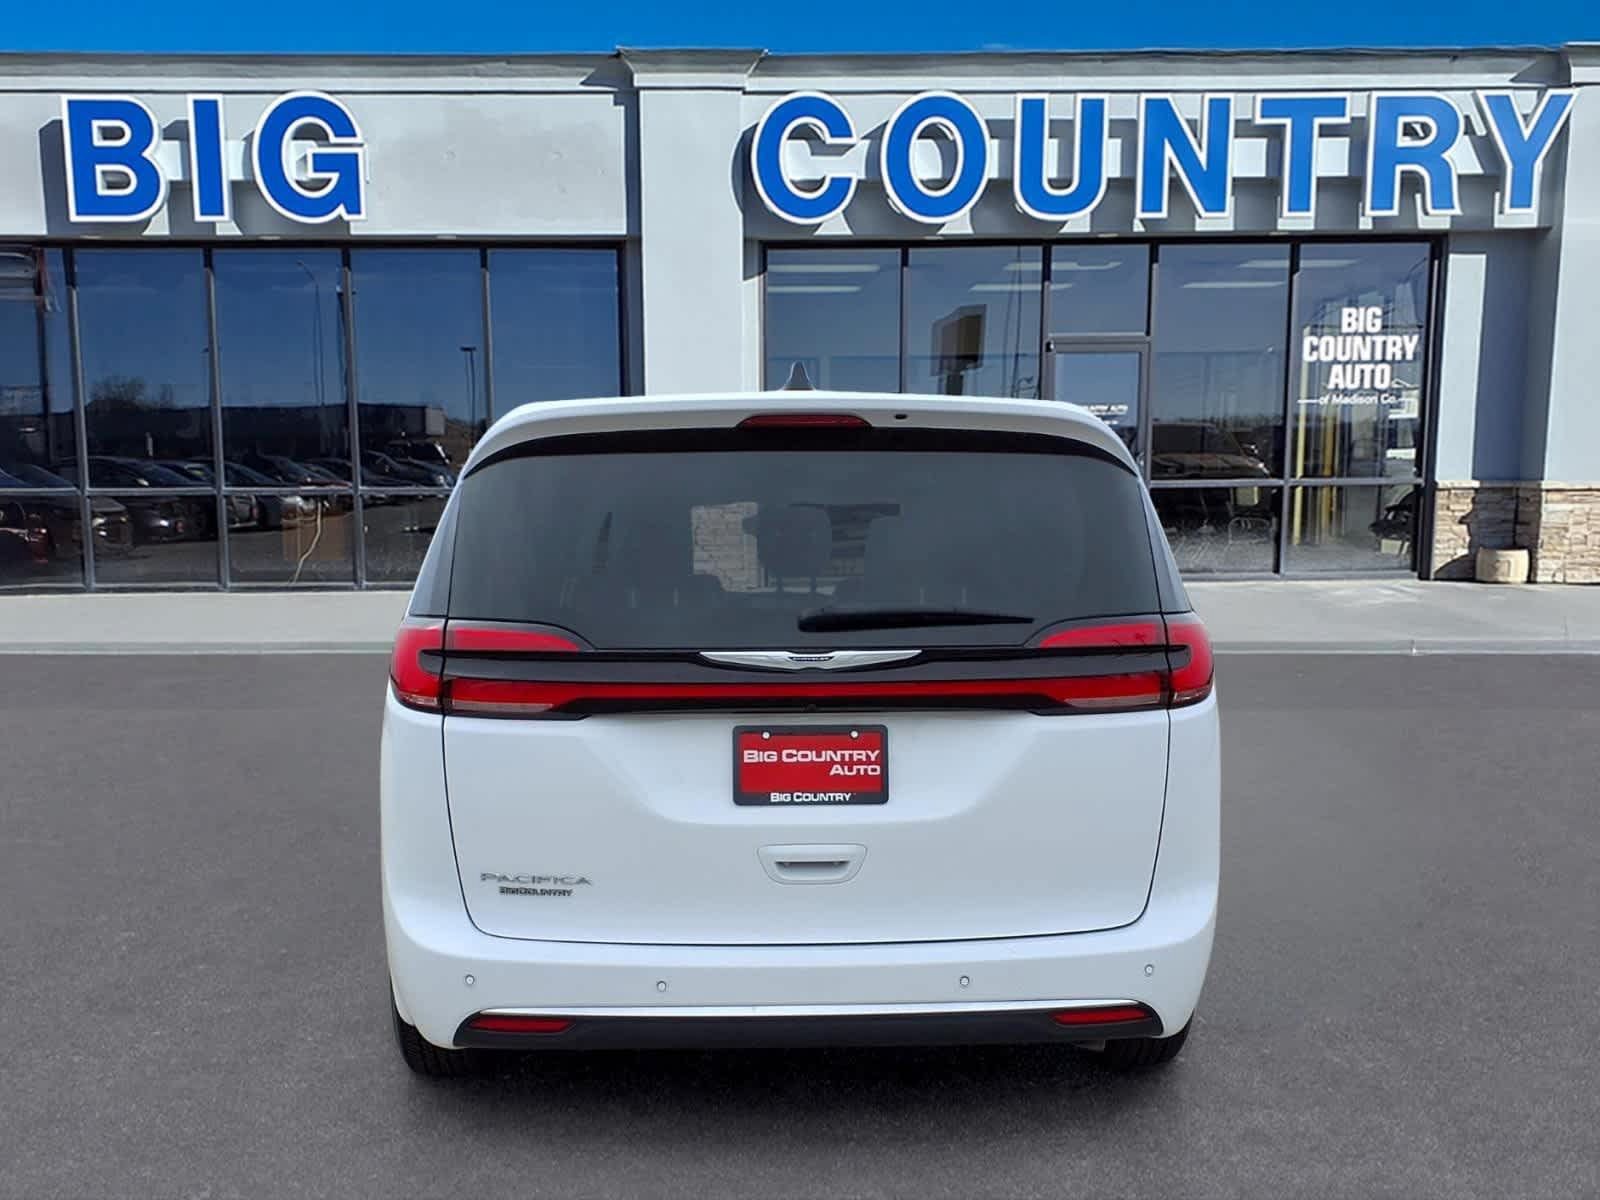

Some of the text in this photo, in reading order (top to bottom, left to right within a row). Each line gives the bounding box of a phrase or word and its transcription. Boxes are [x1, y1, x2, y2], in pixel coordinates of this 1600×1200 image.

[62, 90, 1576, 226] BIG COUNTRY
[1341, 306, 1382, 334] BIG
[1302, 334, 1419, 362] COUNTRY
[1327, 363, 1391, 390] AUTO
[743, 749, 880, 763] BIG COUNTRY
[829, 764, 881, 776] AUTO
[770, 792, 851, 802] BIG COUNTRY
[480, 872, 592, 886] PACIFICA
